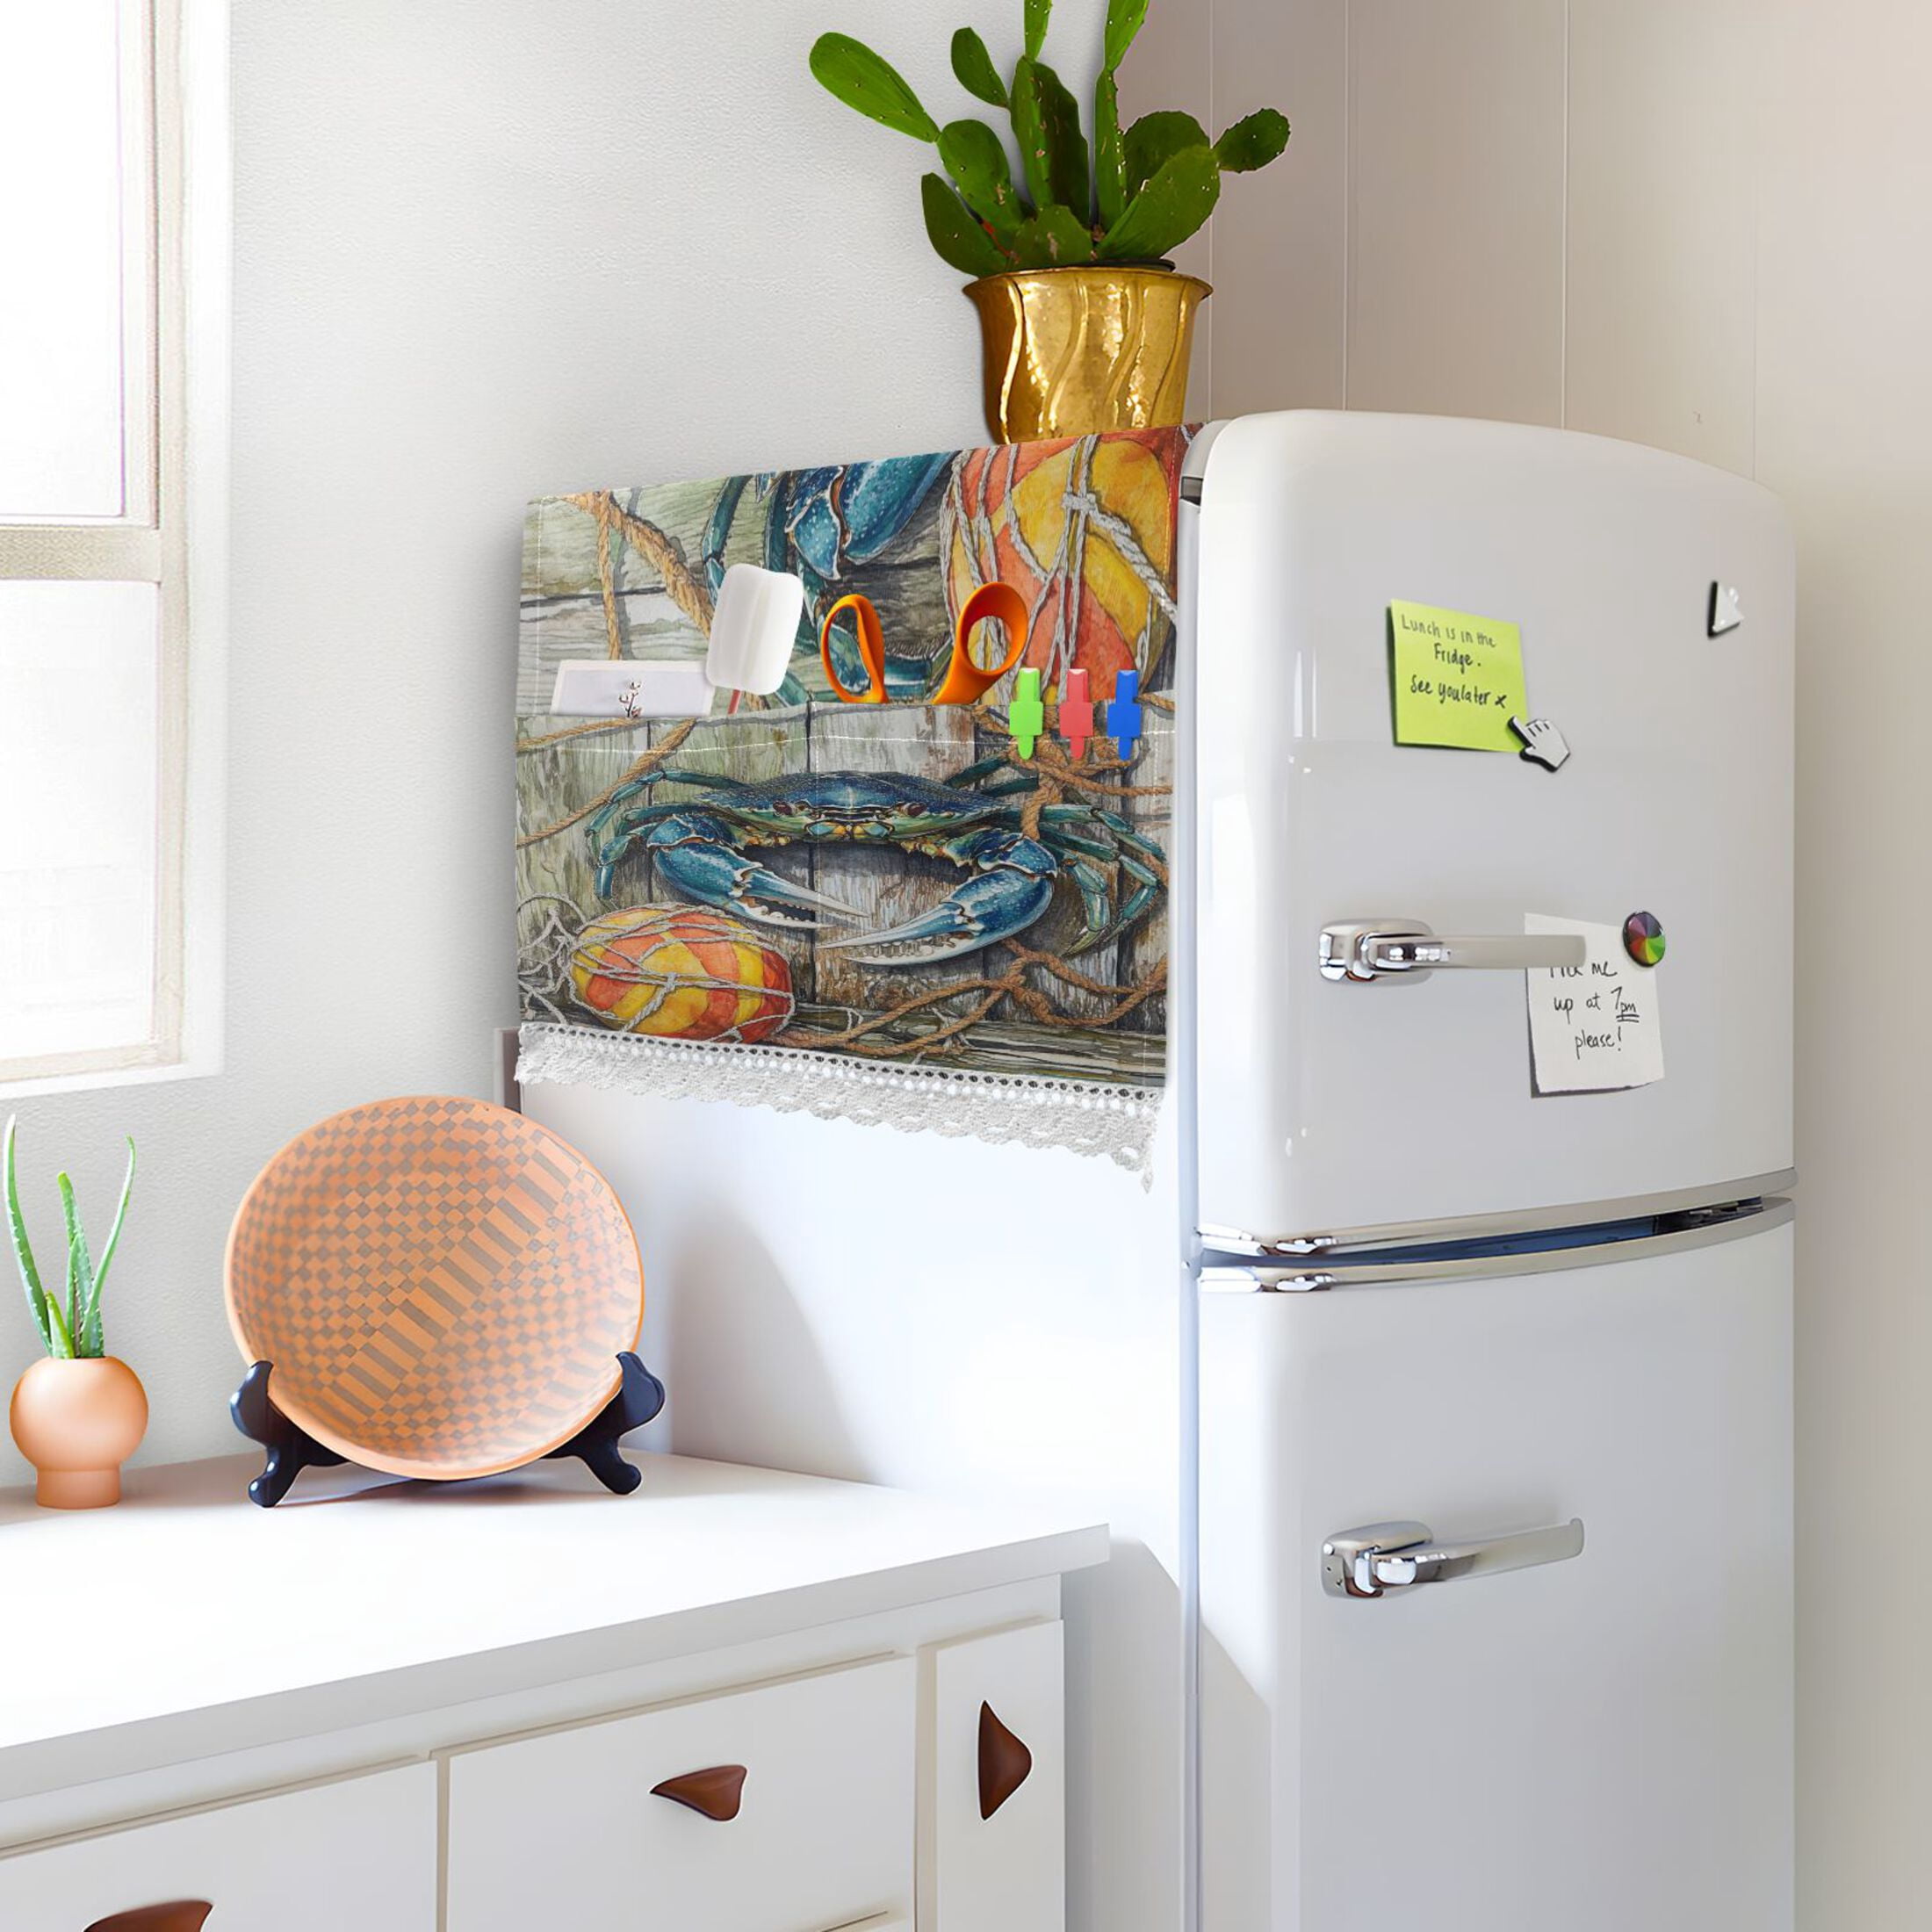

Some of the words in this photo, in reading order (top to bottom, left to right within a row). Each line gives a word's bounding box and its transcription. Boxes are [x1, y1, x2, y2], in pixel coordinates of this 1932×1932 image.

[1402, 614, 1441, 639] Lunch
[1445, 627, 1456, 640] is
[1461, 631, 1474, 644] in
[1476, 631, 1496, 648] the
[1410, 674, 1433, 695] See
[1591, 961, 1618, 977] me
[1554, 997, 1574, 1024] up
[1586, 992, 1602, 1010] at
[1575, 1026, 1621, 1060] please!
